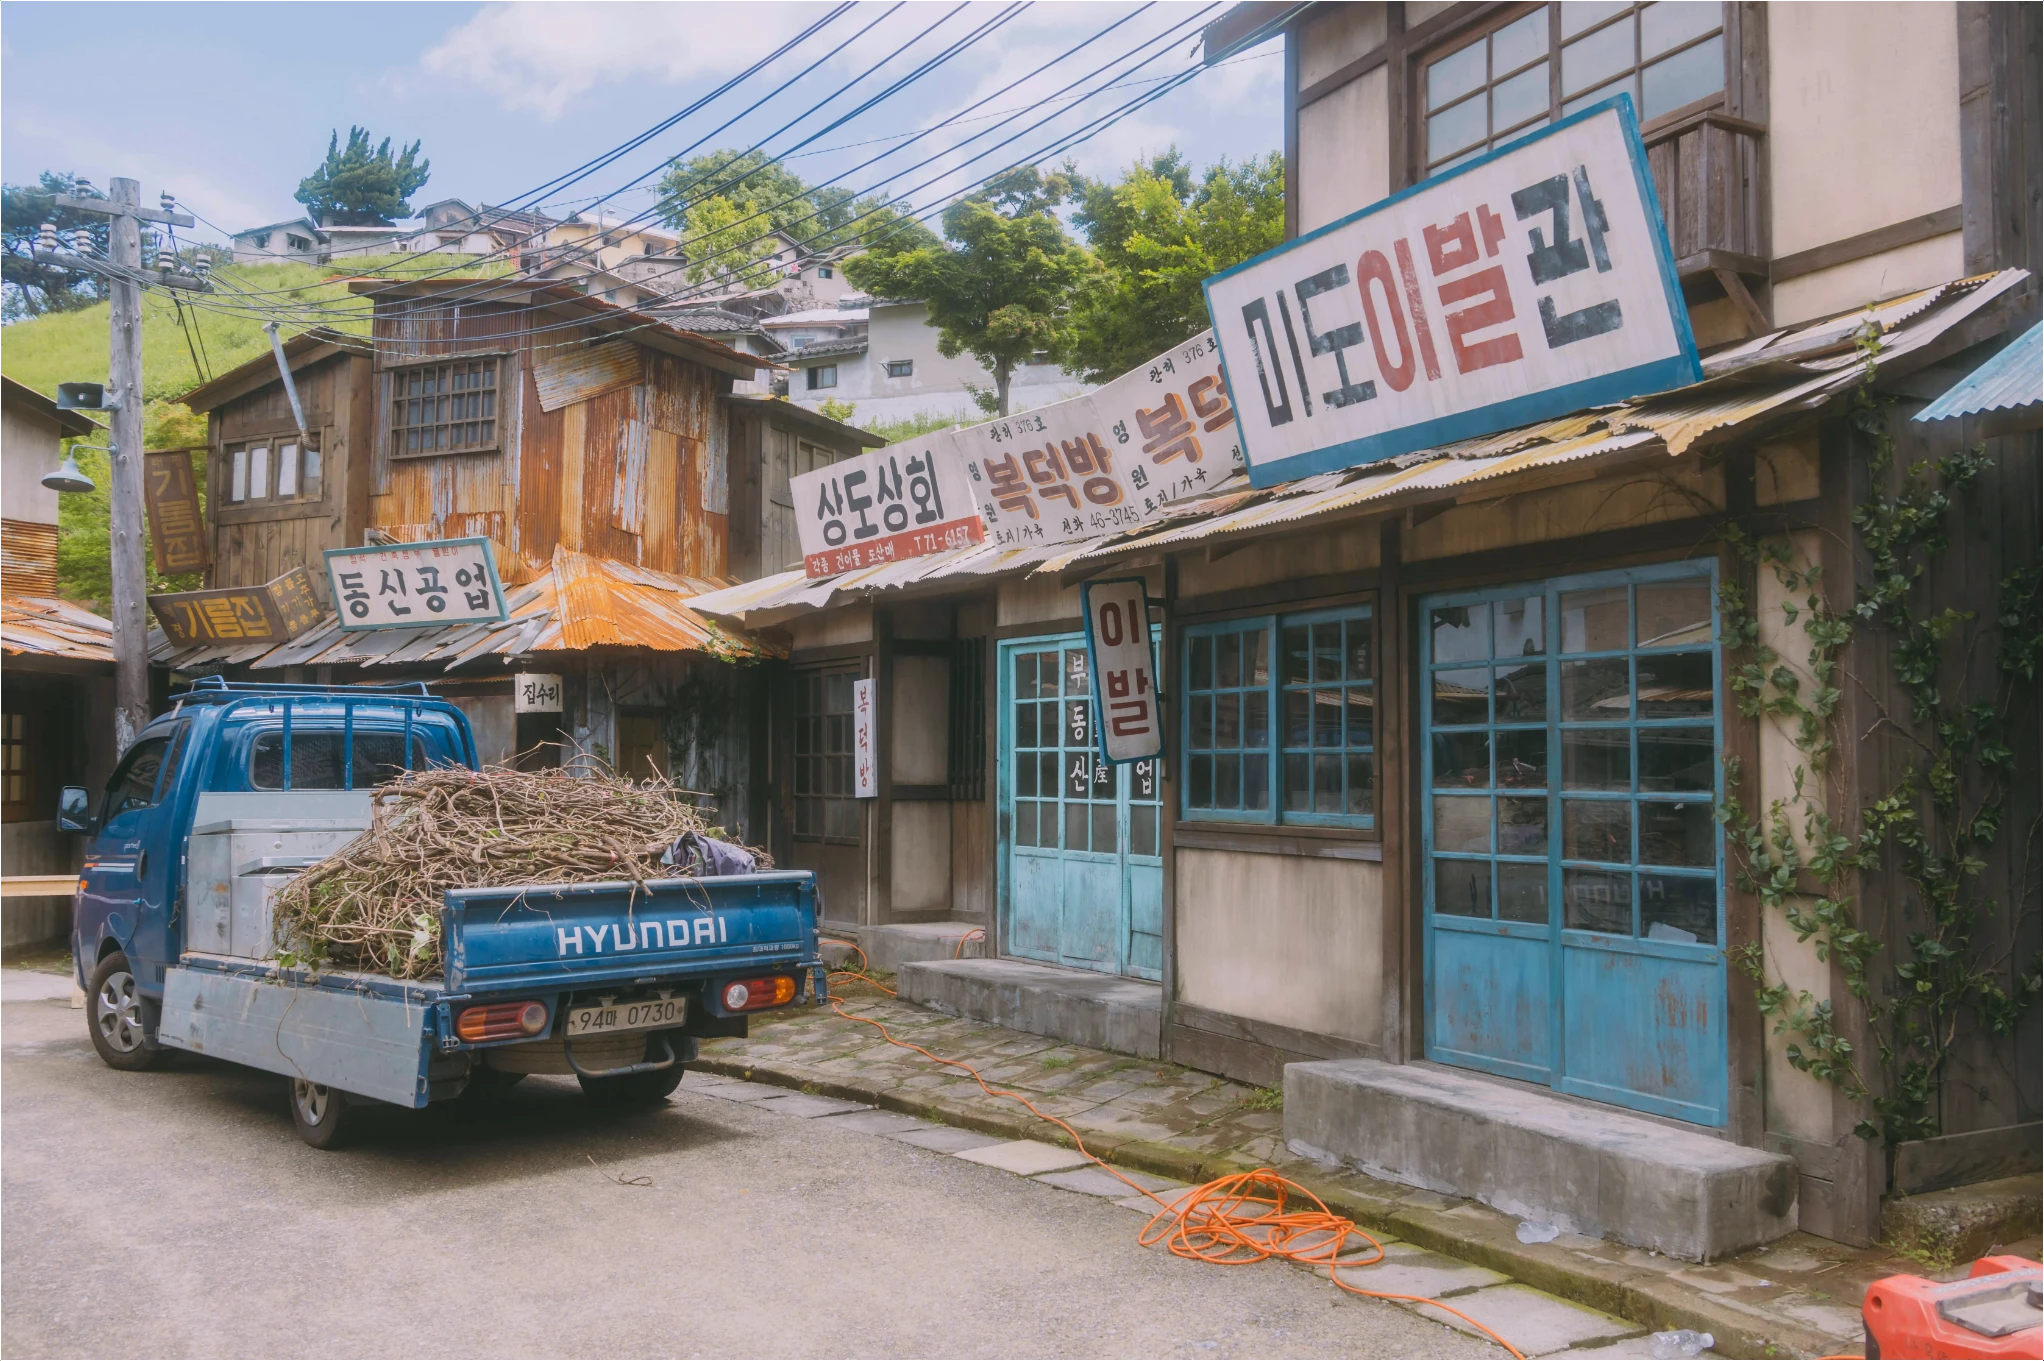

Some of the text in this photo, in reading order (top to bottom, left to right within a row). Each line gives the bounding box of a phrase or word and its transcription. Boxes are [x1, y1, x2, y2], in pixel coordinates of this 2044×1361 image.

[1242, 164, 1624, 428] 미도이발관
[817, 449, 945, 547] 상도상회
[984, 432, 1124, 521] 복덕방
[152, 469, 200, 567] 기름집
[1062, 515, 1084, 535] 전화
[1090, 505, 1140, 529] 46-3745
[338, 562, 490, 619] 동신공업
[812, 559, 828, 574] 각종
[836, 552, 861, 570] 건어물
[868, 541, 895, 563] 도산매
[174, 596, 273, 639] 기름집
[523, 682, 559, 706] 집수리
[1099, 599, 1150, 737] 이발
[858, 686, 870, 788] 복덕방
[1070, 654, 1089, 792] 부동산
[557, 916, 727, 956] HYUNDAI
[579, 1001, 675, 1032] 94마 0730
